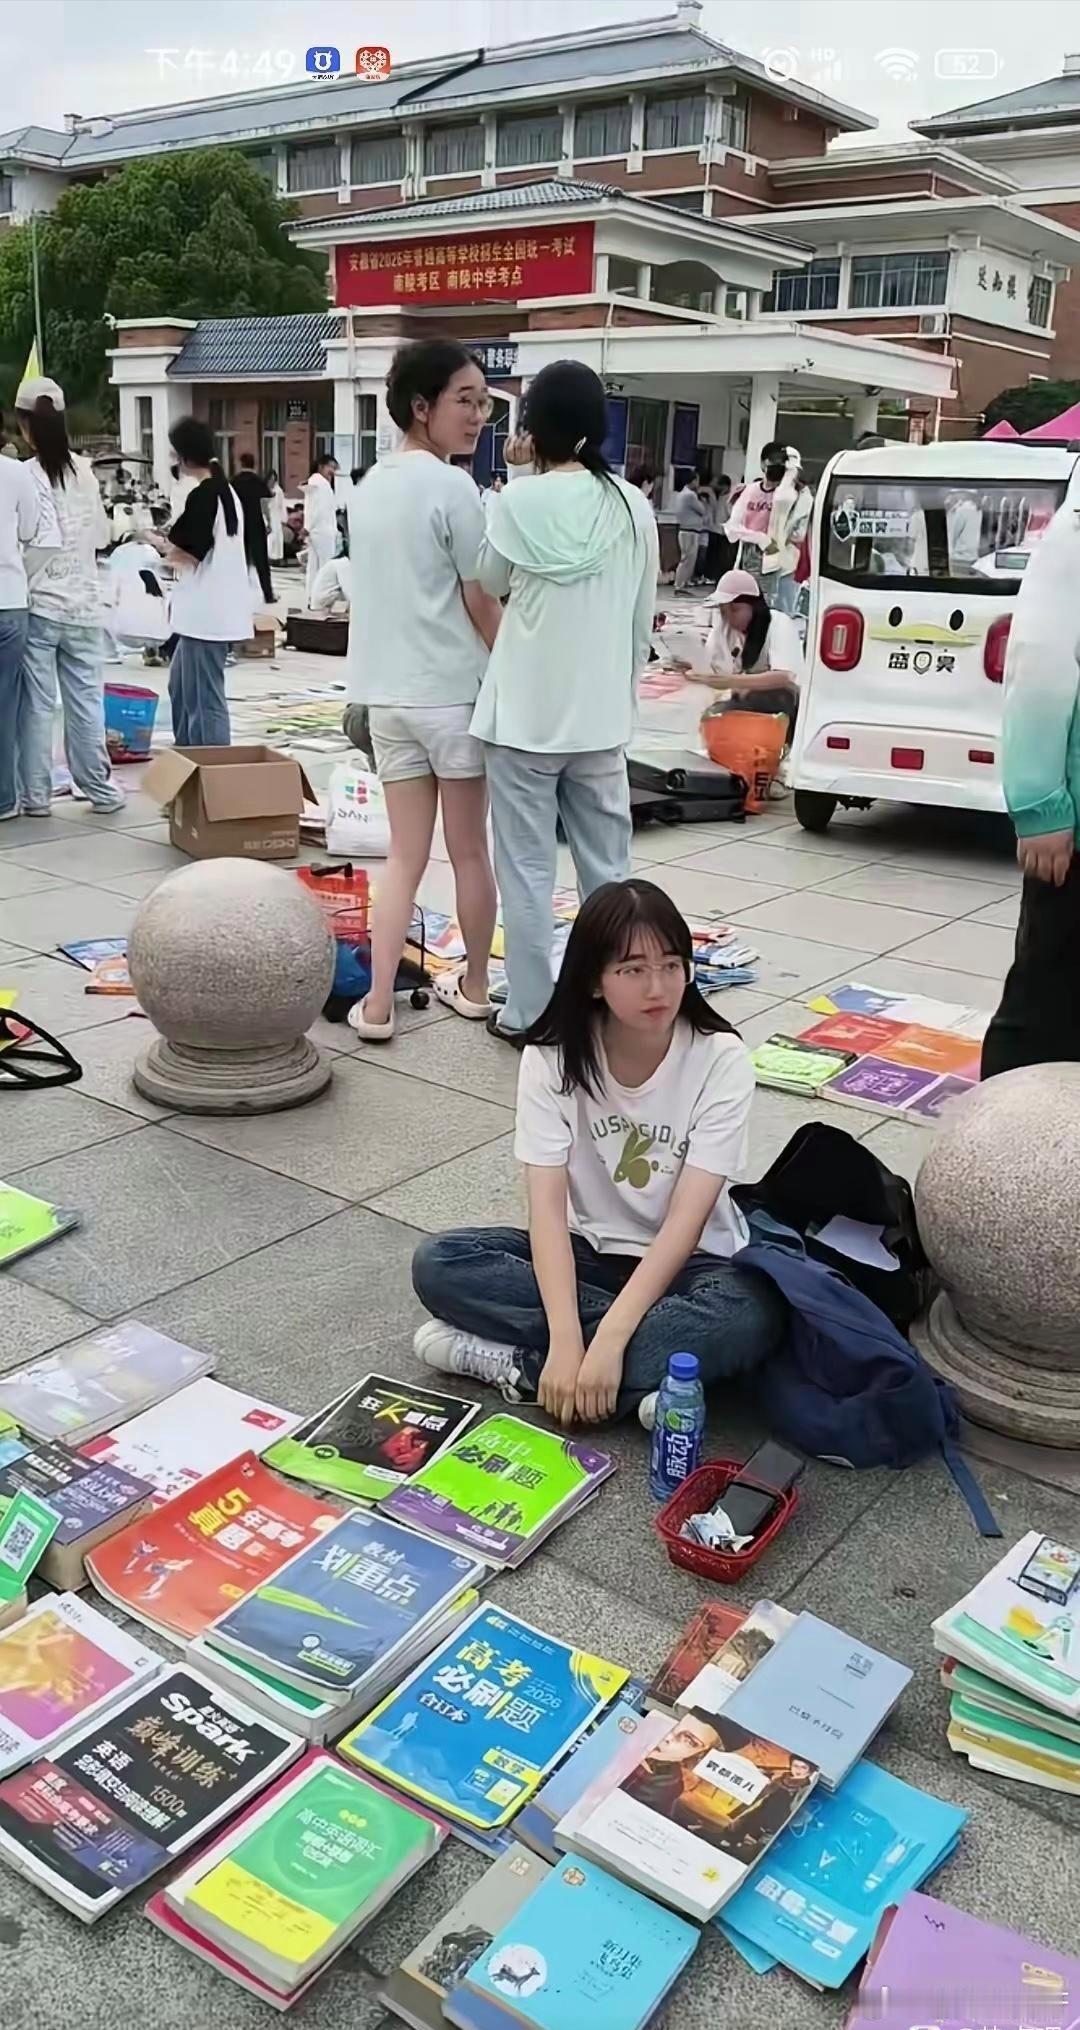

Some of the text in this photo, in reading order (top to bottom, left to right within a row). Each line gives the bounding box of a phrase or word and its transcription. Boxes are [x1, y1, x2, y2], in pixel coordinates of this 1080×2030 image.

[393, 265, 523, 293] 南陵考区 南陵中学考点
[452, 1443, 548, 1490] 必刷题
[665, 1432, 696, 1480] 脉动
[312, 1544, 421, 1606] 划重点
[362, 1540, 406, 1565] 教材
[455, 1636, 533, 1688] 高考
[418, 1691, 468, 1724] 合订本
[432, 1664, 547, 1734] 必刷题
[523, 1684, 563, 1709] 2026
[160, 1691, 258, 1763] Spark
[92, 1739, 134, 1770] 英语
[73, 1754, 173, 1832] 完形填空与阅读理解
